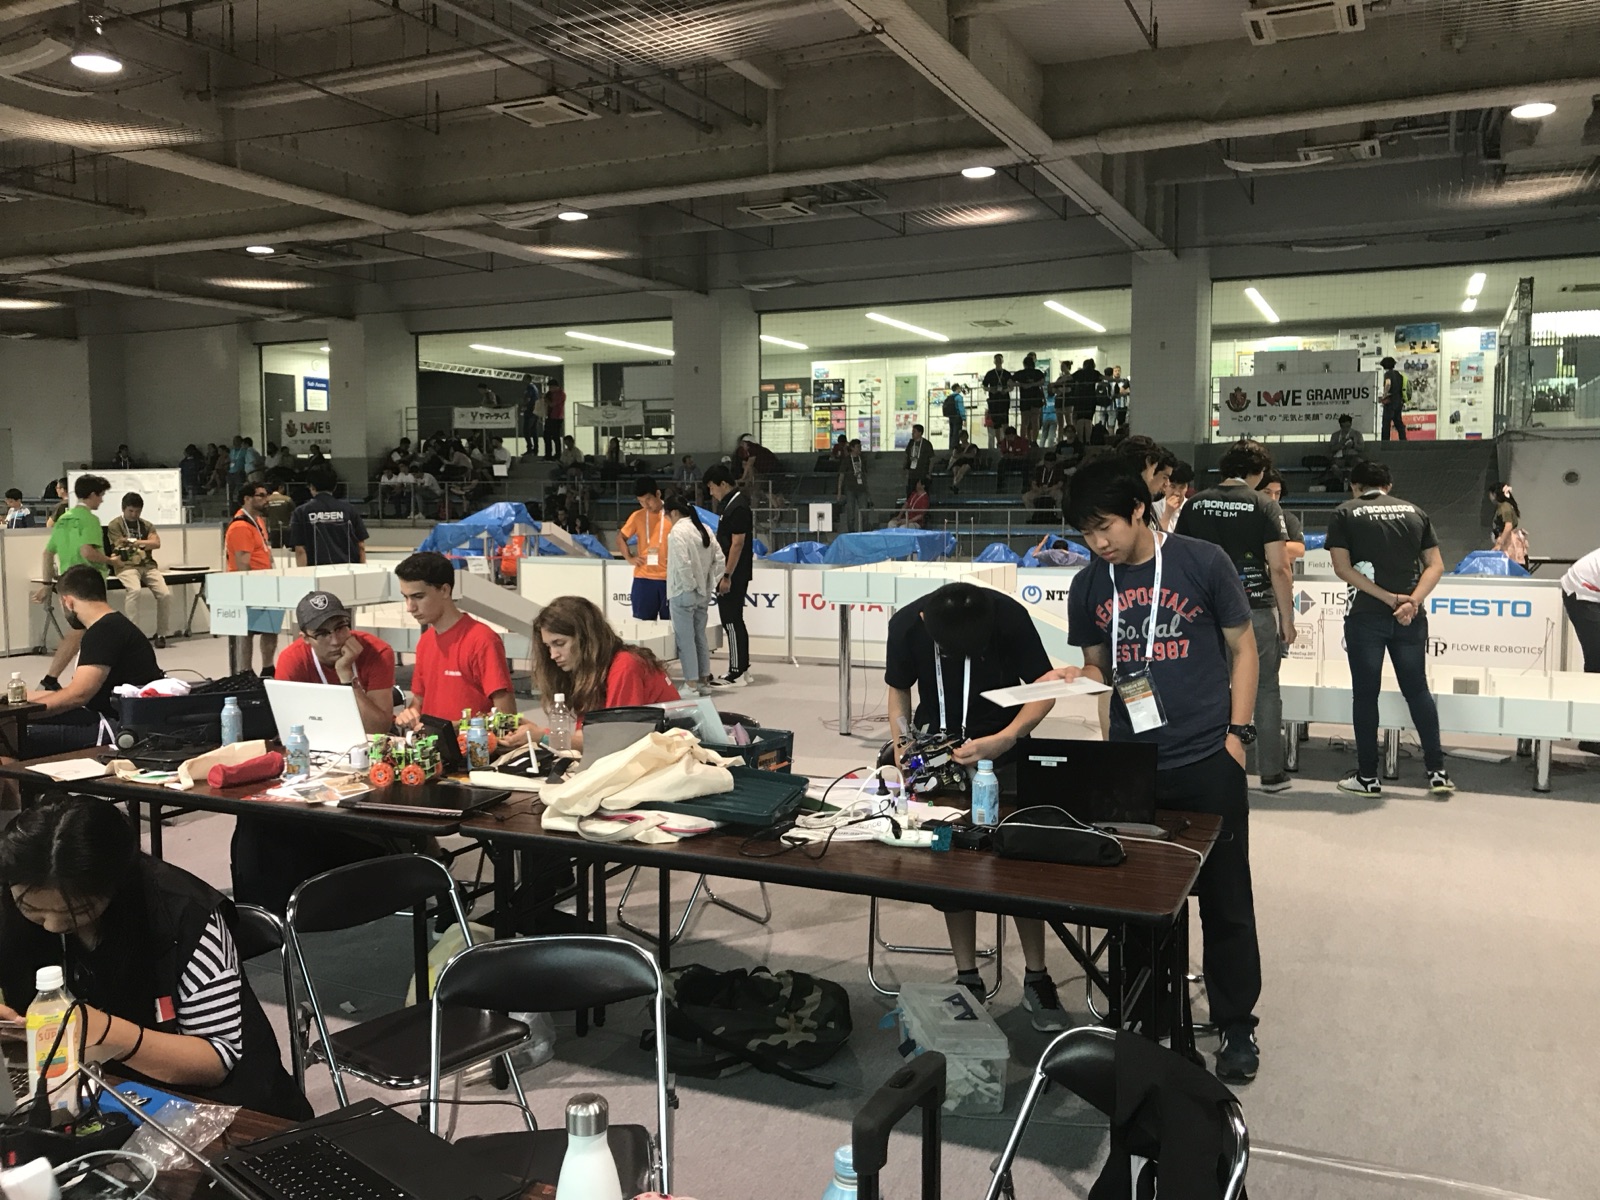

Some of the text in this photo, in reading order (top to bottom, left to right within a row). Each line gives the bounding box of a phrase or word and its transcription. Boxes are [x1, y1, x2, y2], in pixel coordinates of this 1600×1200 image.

[1306, 387, 1370, 401] GRAMPUS
[1203, 509, 1238, 518] ITESM
[1369, 513, 1406, 521] ITESM
[707, 592, 780, 608] SNY
[1320, 592, 1346, 605] TIS
[216, 608, 236, 618] Field
[1431, 598, 1532, 618] FESTO
[1145, 639, 1190, 663] 987
[1451, 643, 1543, 655] FLOWER ROBOTICS
